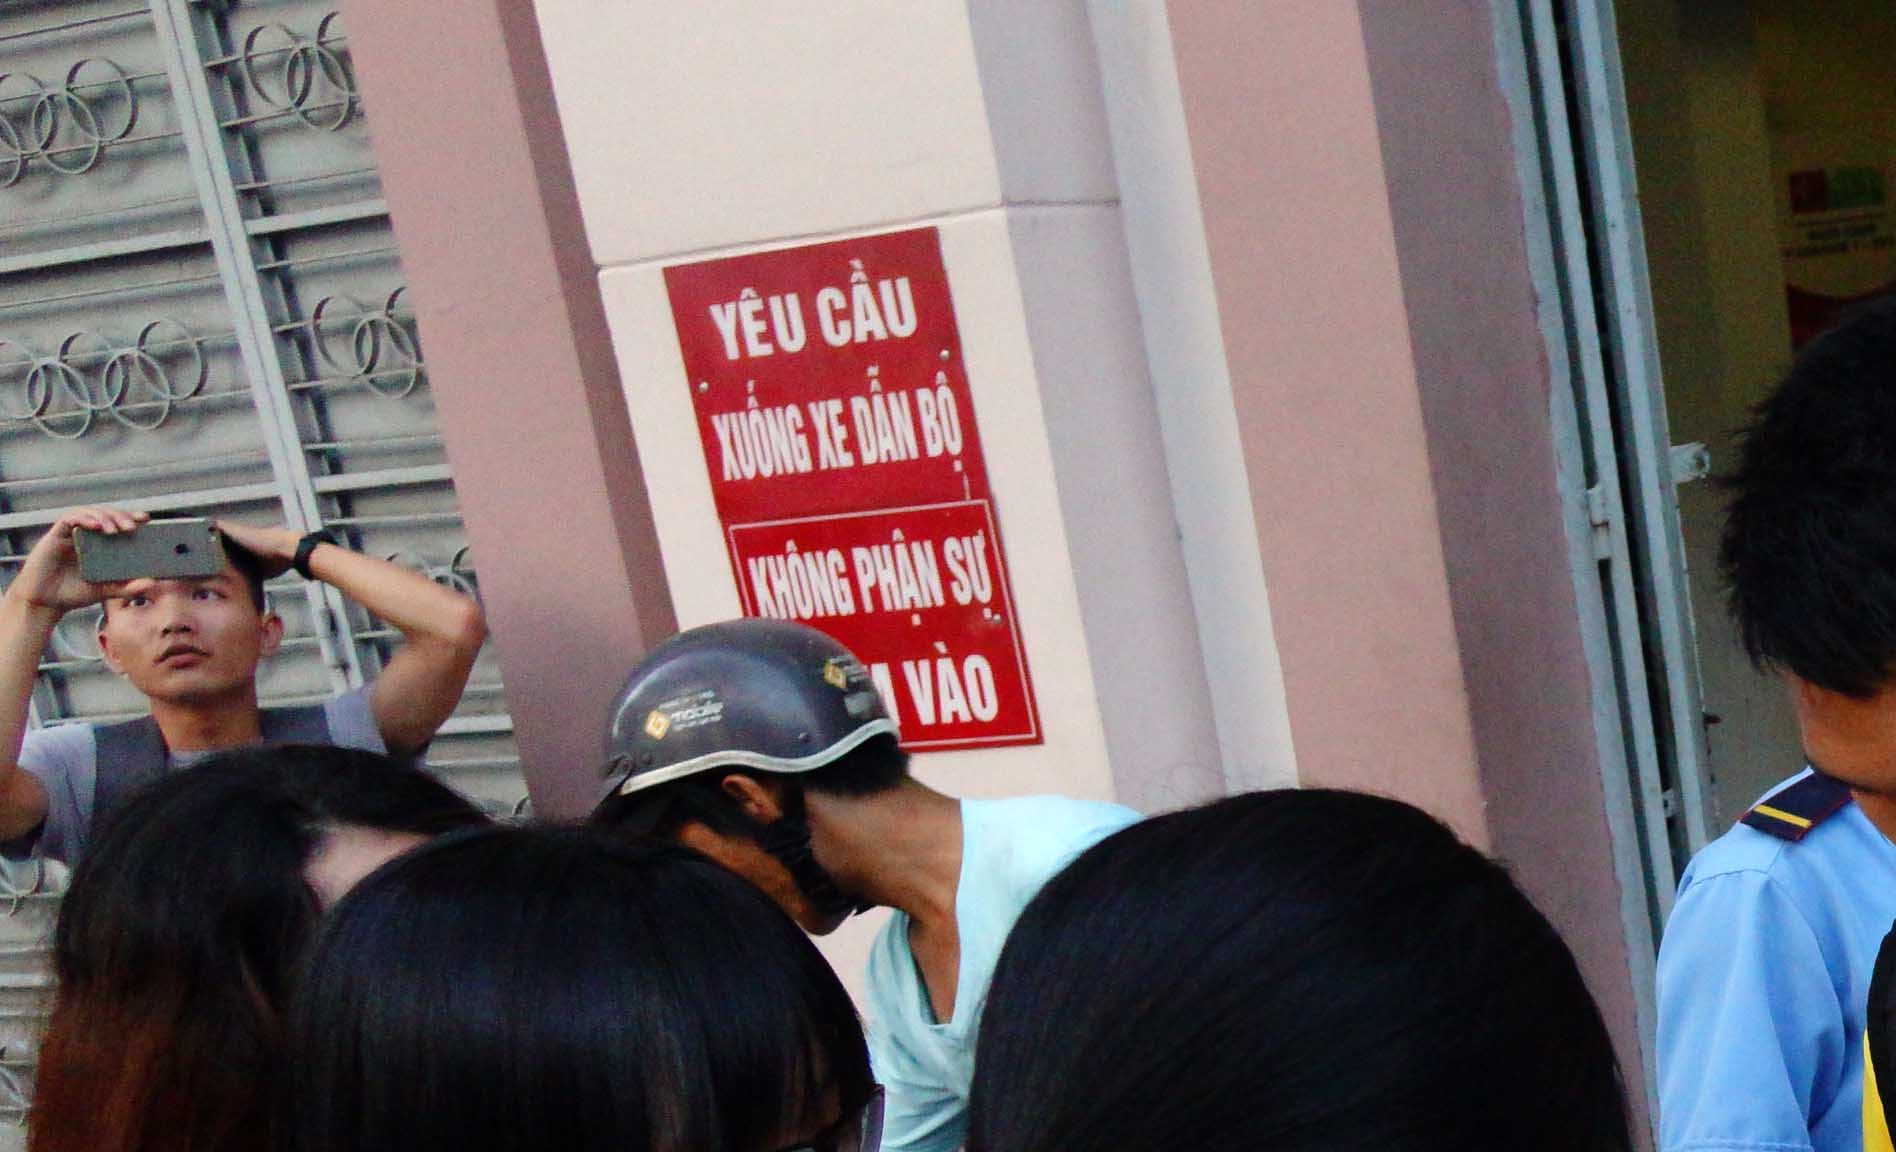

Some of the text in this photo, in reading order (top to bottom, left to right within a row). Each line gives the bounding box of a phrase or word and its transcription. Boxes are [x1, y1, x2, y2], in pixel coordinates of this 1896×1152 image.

[709, 258, 918, 361] YÊU CẦU
[711, 364, 963, 482] XUỐNG XE DẪN BỘ
[747, 527, 994, 627] KHÔNG PHẬN SỰ
[902, 641, 999, 726] VÀO
